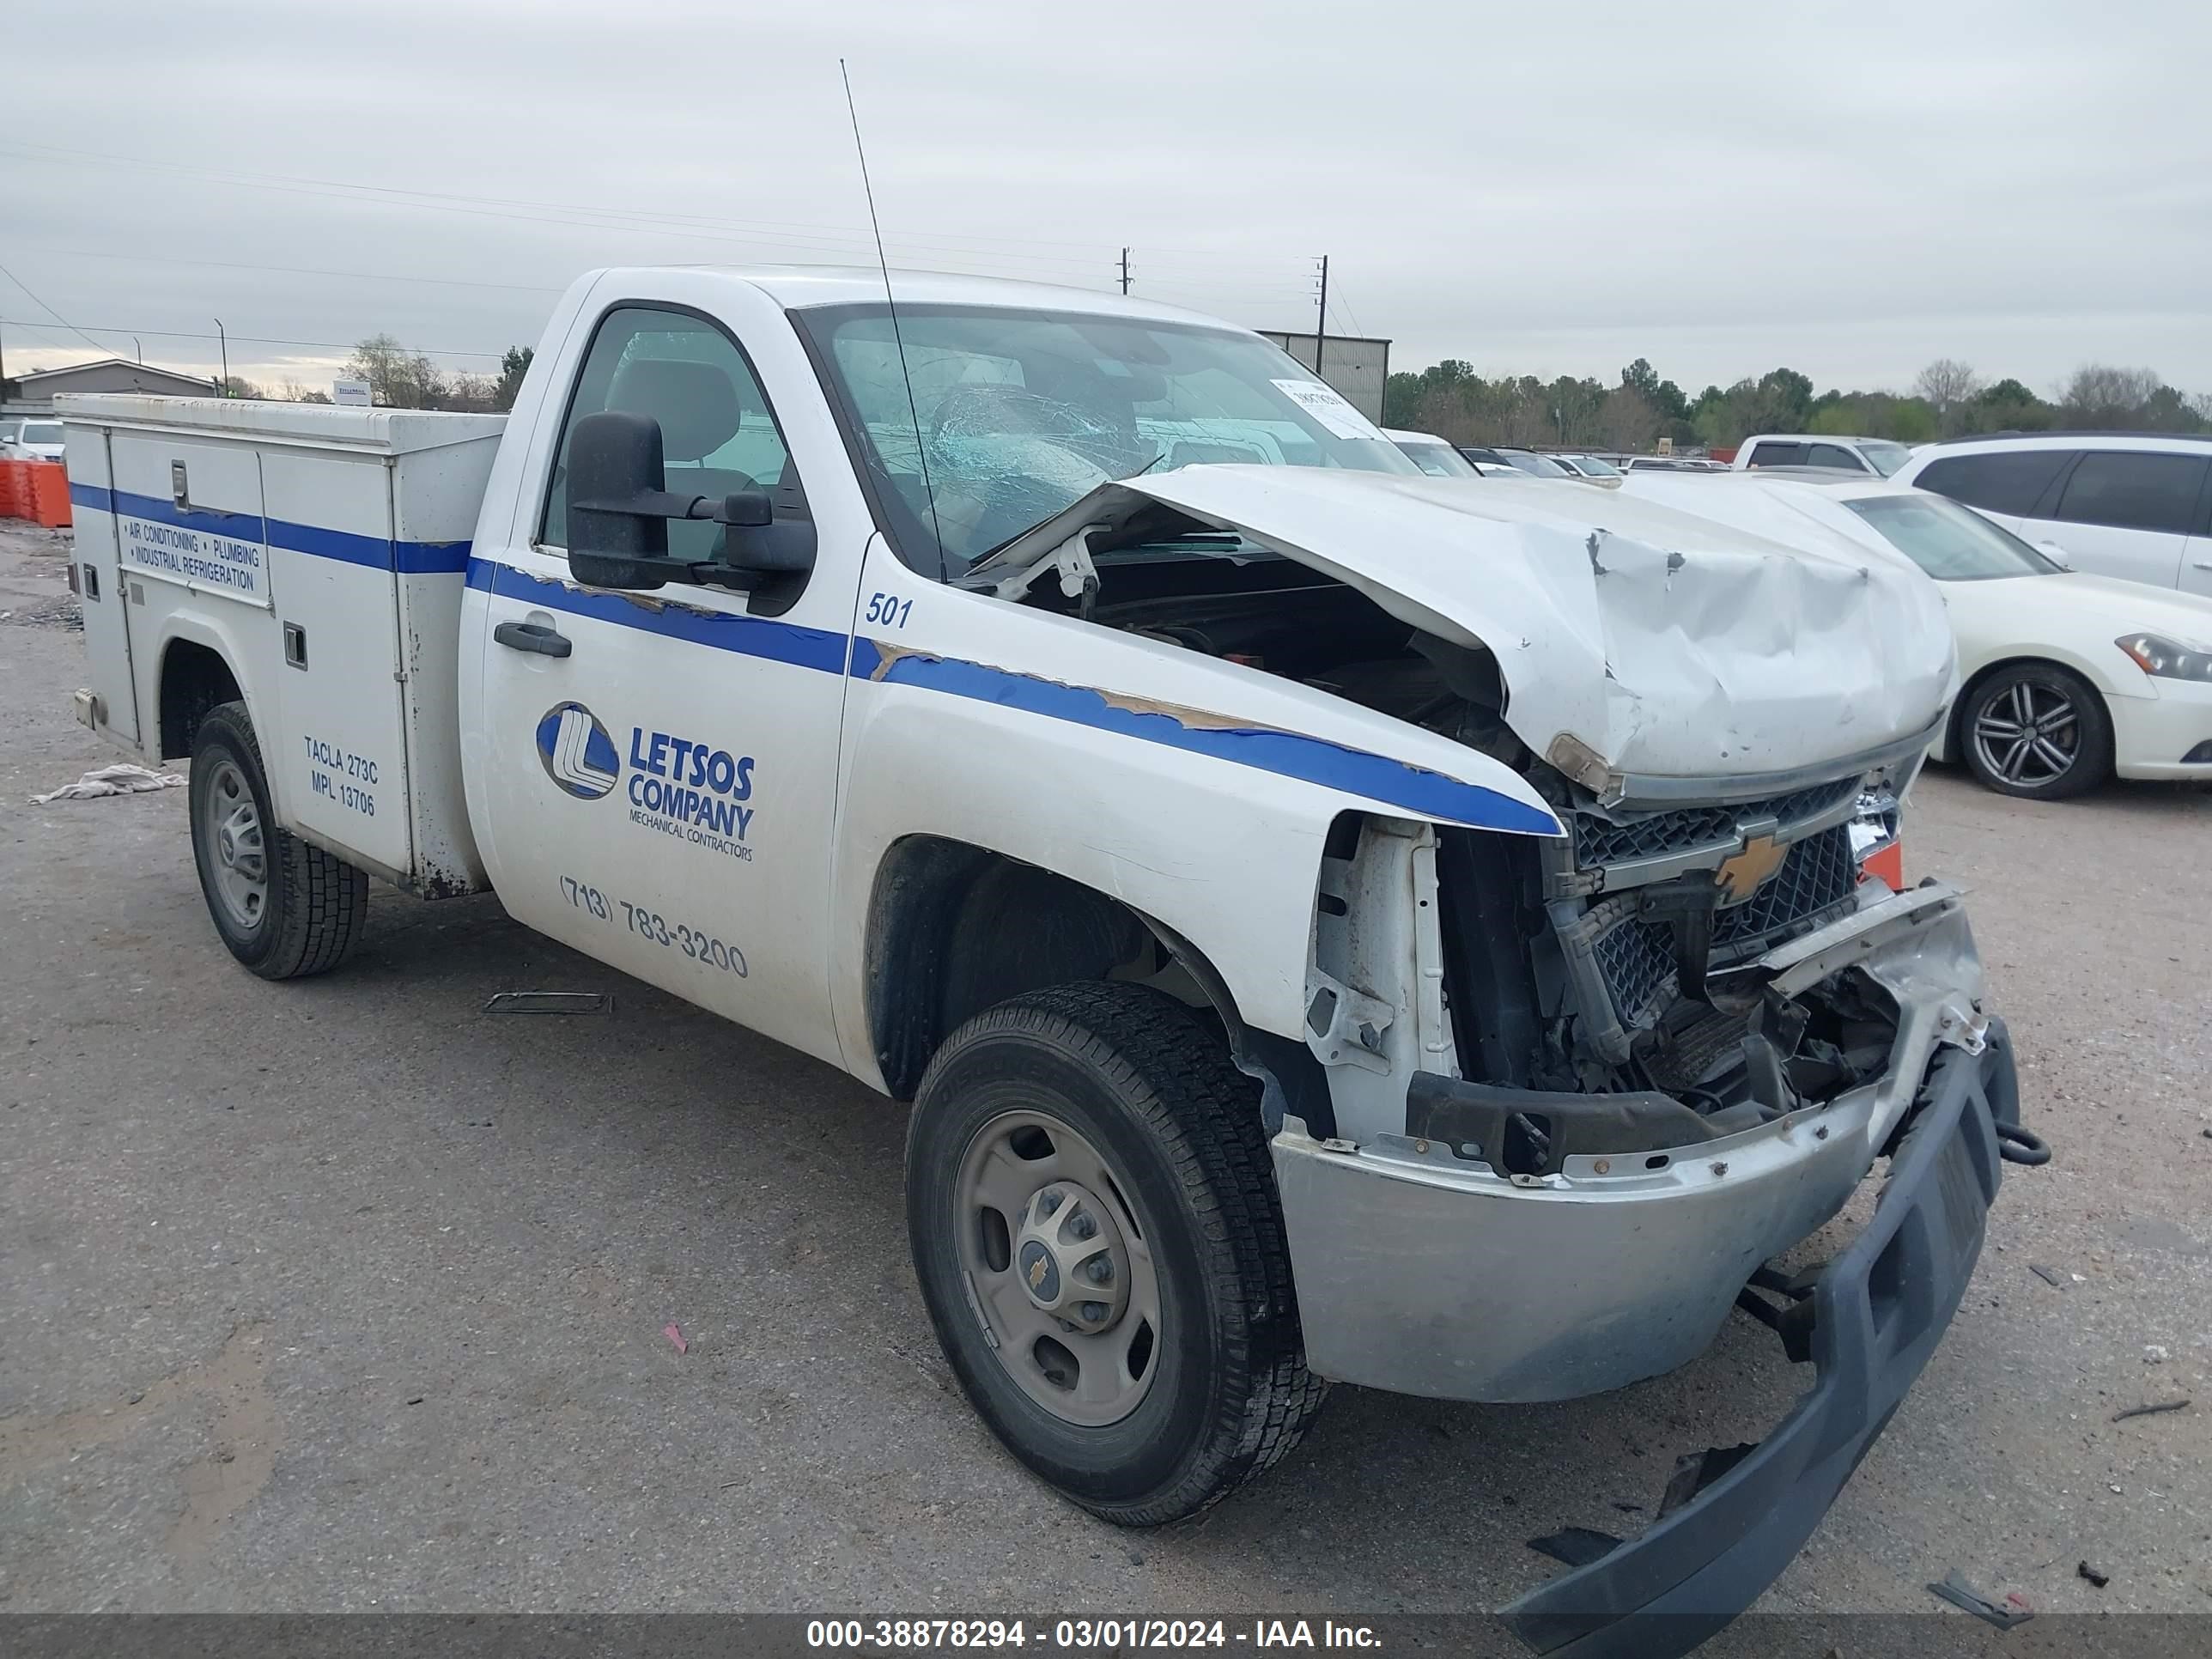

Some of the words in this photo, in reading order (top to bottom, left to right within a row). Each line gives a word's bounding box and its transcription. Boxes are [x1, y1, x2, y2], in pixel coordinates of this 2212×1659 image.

[129, 521, 142, 538] AIR
[143, 524, 198, 553] CONDITIONING
[213, 539, 259, 568] PLUMBING
[136, 545, 182, 573] INDUSTRIAL
[183, 556, 254, 592] REFRIGERATION
[866, 592, 914, 629] 501
[304, 734, 344, 772] TACLA
[347, 753, 379, 785] 273C
[629, 726, 755, 801] LETSOS
[311, 769, 337, 800] MPL
[340, 783, 375, 817] 13706
[628, 774, 754, 842] COMPANY
[629, 809, 684, 839] MECHANICAL
[686, 829, 753, 863] CONTRACTORS
[560, 875, 613, 922] (713)
[619, 900, 749, 979] 783-3200
